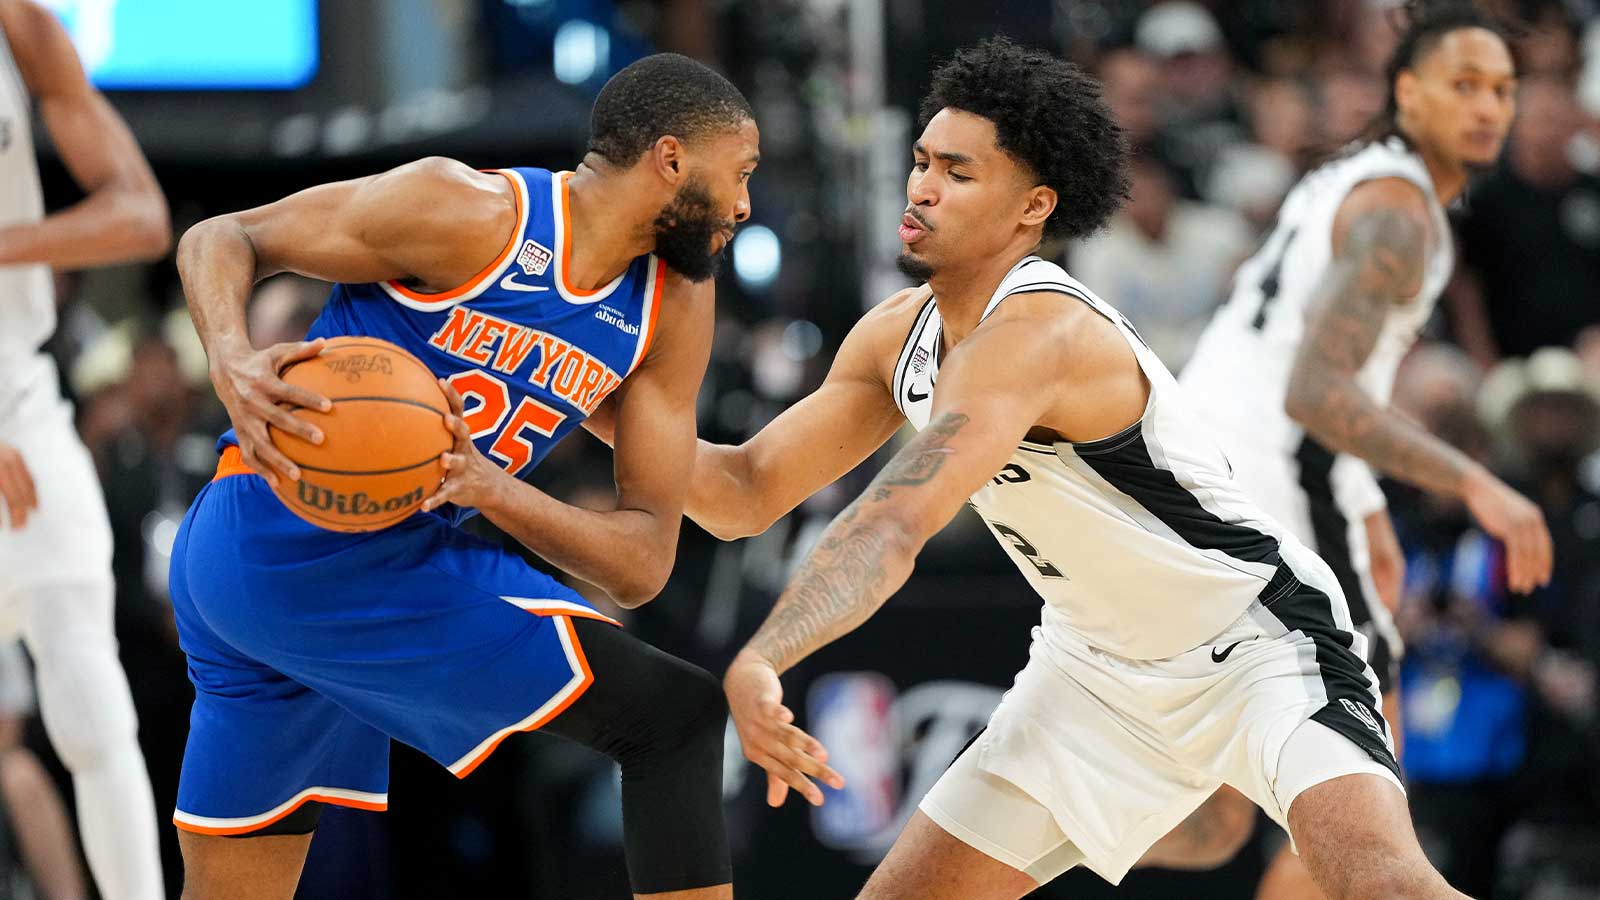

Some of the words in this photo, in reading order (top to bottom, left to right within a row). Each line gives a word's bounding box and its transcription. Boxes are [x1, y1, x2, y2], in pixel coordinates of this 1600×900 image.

[520, 255, 544, 273] 250
[526, 244, 548, 261] USA
[595, 310, 616, 325] abu
[428, 305, 540, 375] NEW
[446, 369, 567, 478] 25
[297, 479, 424, 515] Wilson
[988, 520, 1069, 580] 2
